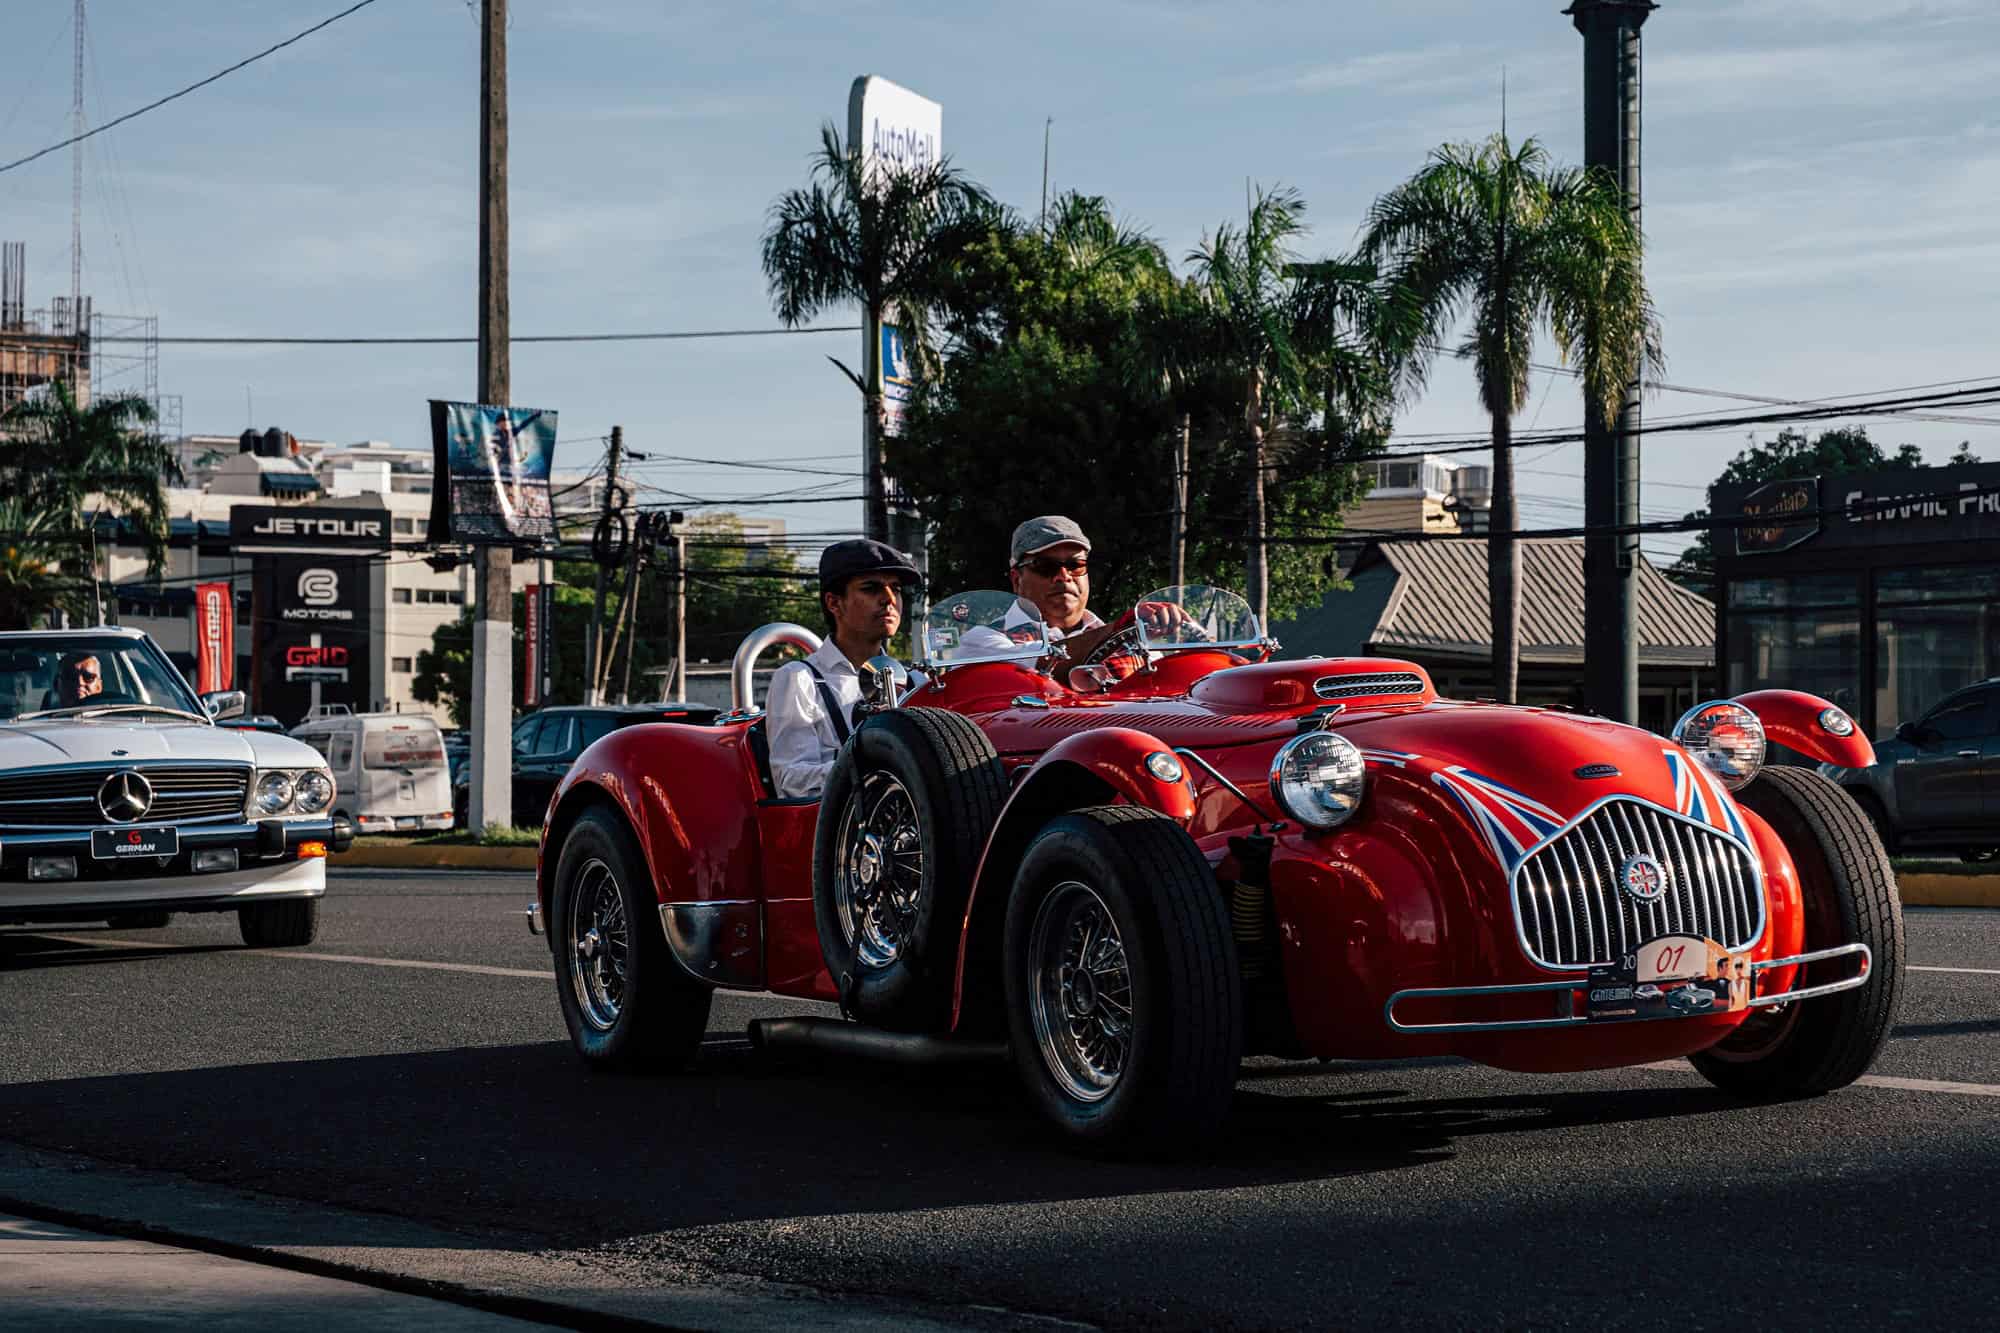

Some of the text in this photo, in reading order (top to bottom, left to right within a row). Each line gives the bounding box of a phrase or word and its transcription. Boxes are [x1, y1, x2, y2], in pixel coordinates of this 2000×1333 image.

[872, 117, 933, 170] AutoMall
[253, 517, 382, 537] JETOUR
[283, 608, 353, 620] MOTORS
[286, 646, 348, 666] GRID
[115, 843, 156, 853] GERMAN
[1656, 945, 1686, 974] 01
